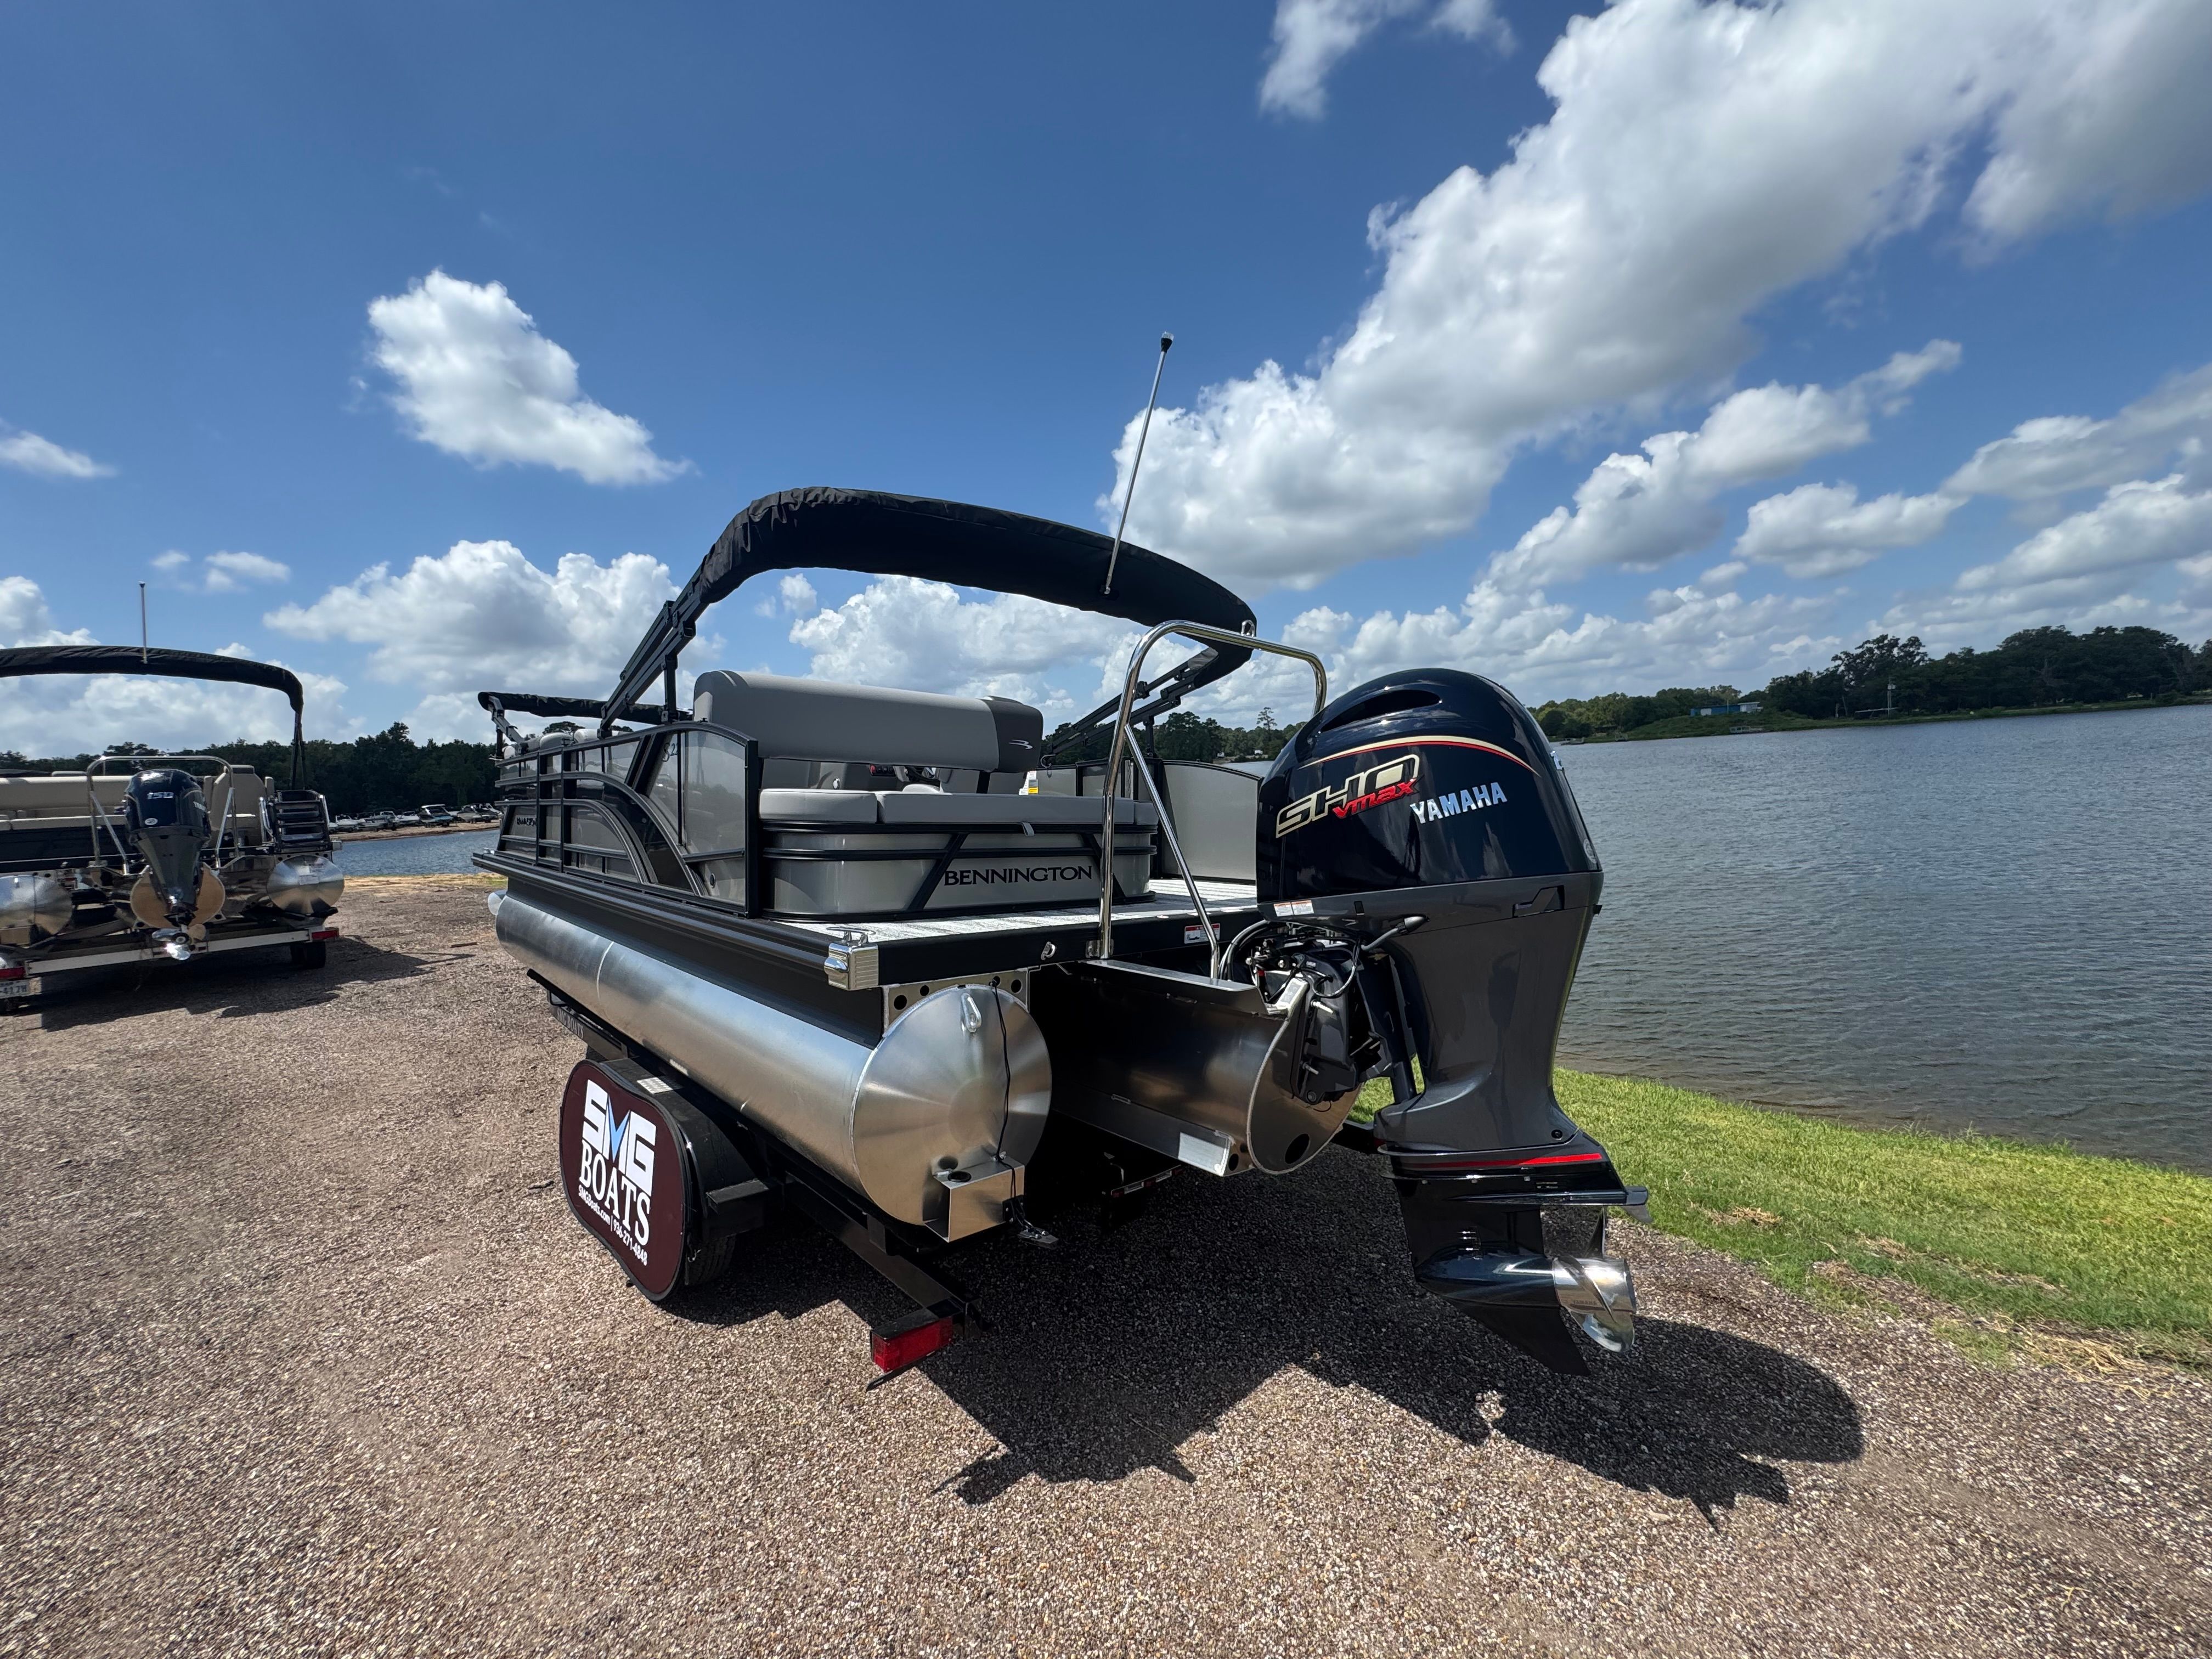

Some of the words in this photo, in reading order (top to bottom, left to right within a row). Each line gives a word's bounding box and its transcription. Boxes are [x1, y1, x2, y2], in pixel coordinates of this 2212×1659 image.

[1276, 754, 1420, 838] SHO
[1409, 782, 1508, 824] YAMAHA
[944, 865, 1092, 885] BENNINGTON
[567, 1015, 584, 1039] BOATS
[582, 1079, 656, 1197] SMG
[579, 1139, 650, 1246] BOATS
[579, 1184, 611, 1225] SMGBoats.com
